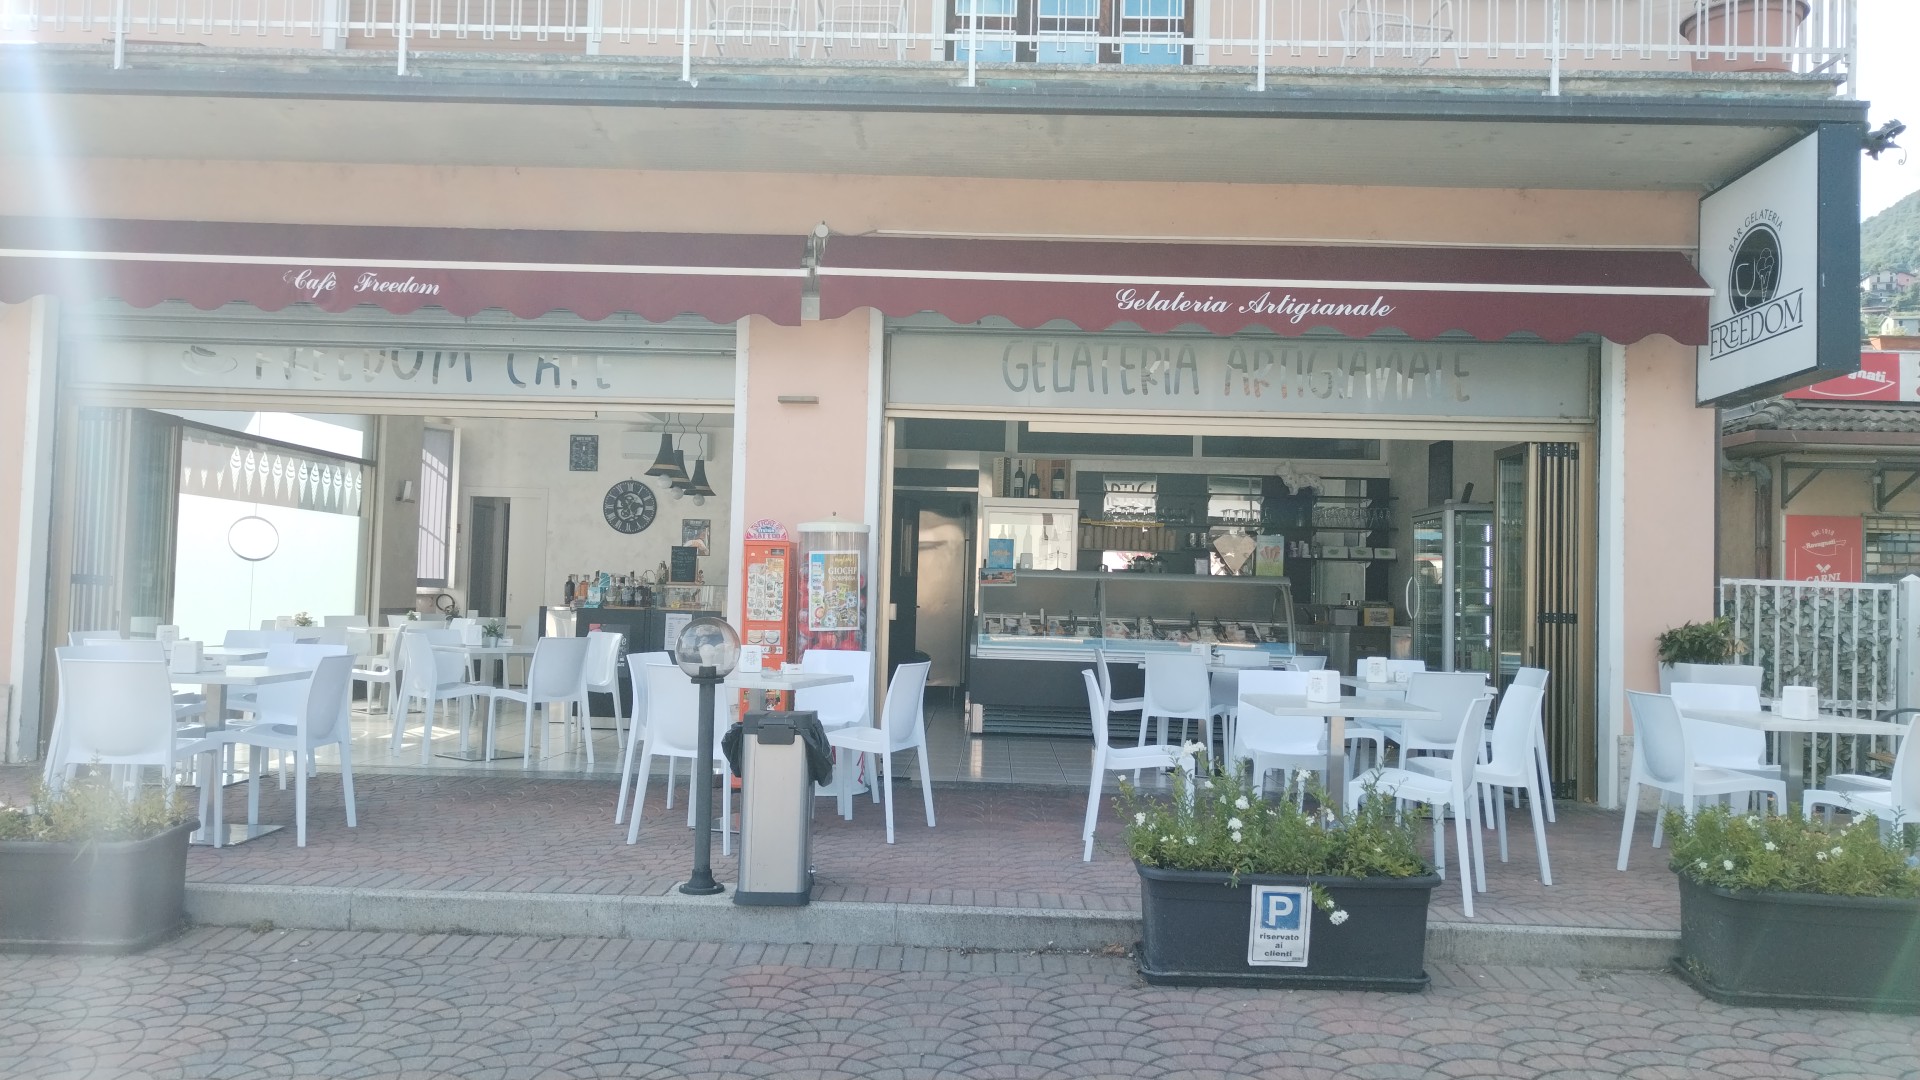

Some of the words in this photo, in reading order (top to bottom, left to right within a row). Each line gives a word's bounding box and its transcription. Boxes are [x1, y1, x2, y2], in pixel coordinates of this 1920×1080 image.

[1728, 227, 1743, 252] BAR
[1744, 209, 1783, 231] GELATERIA
[353, 271, 440, 296] Freedom
[1115, 288, 1233, 313] Gelateria
[1238, 291, 1397, 324] Artigianale
[1710, 293, 1804, 357] FREEDOM
[1001, 339, 1201, 396] GELATERIA
[1269, 895, 1294, 926] P
[1260, 933, 1299, 941] riservato
[1274, 941, 1283, 949] ai
